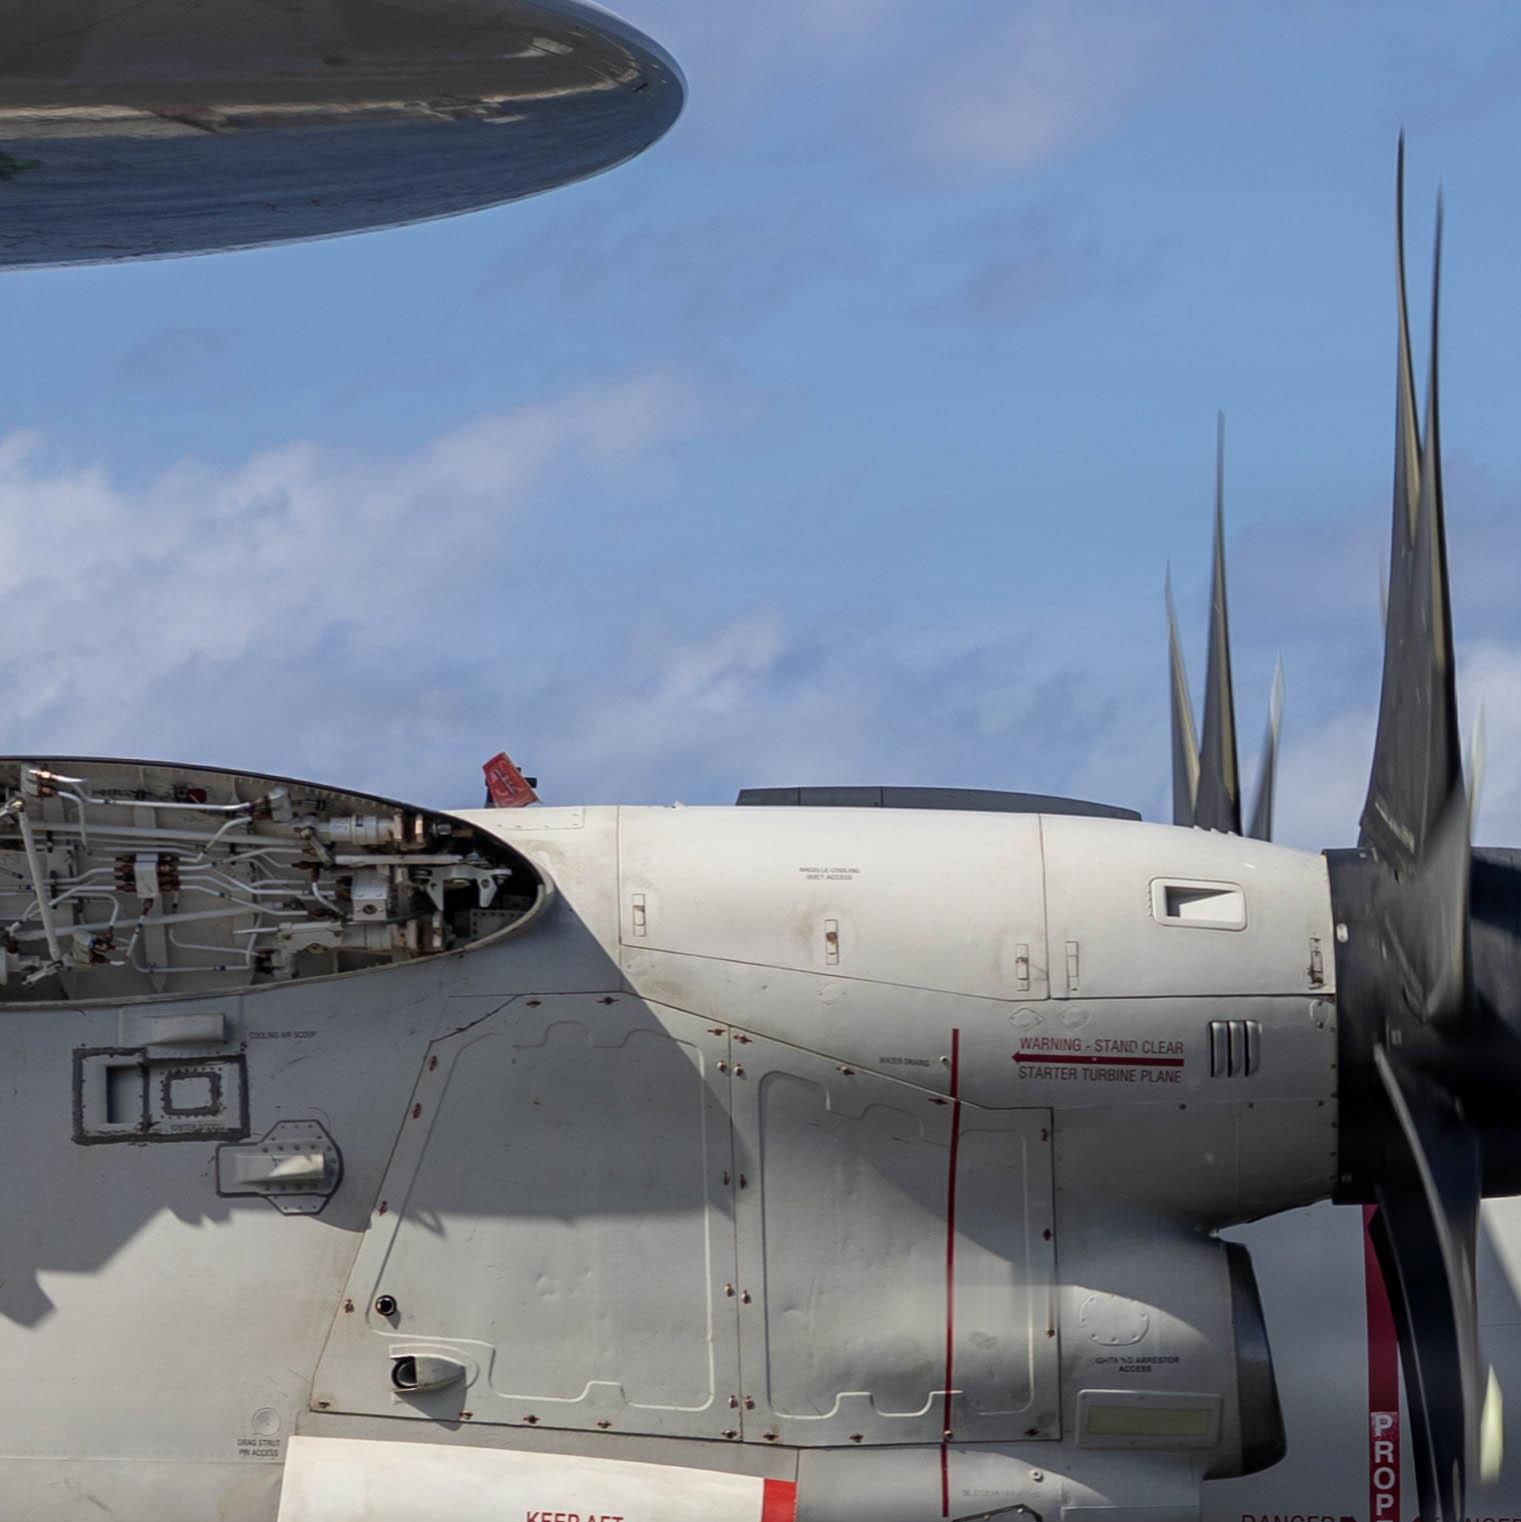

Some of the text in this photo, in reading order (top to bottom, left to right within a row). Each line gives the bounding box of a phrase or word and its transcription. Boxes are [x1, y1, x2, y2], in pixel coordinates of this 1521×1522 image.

[1019, 1037, 1082, 1051] WARNING
[1094, 1039, 1138, 1053] STAND
[1142, 1040, 1184, 1055] CLEAR
[1018, 1066, 1182, 1084] STARTER TURBINE PLANE
[1119, 1365, 1152, 1373] ACCESS
[251, 1449, 279, 1457] ACCESS
